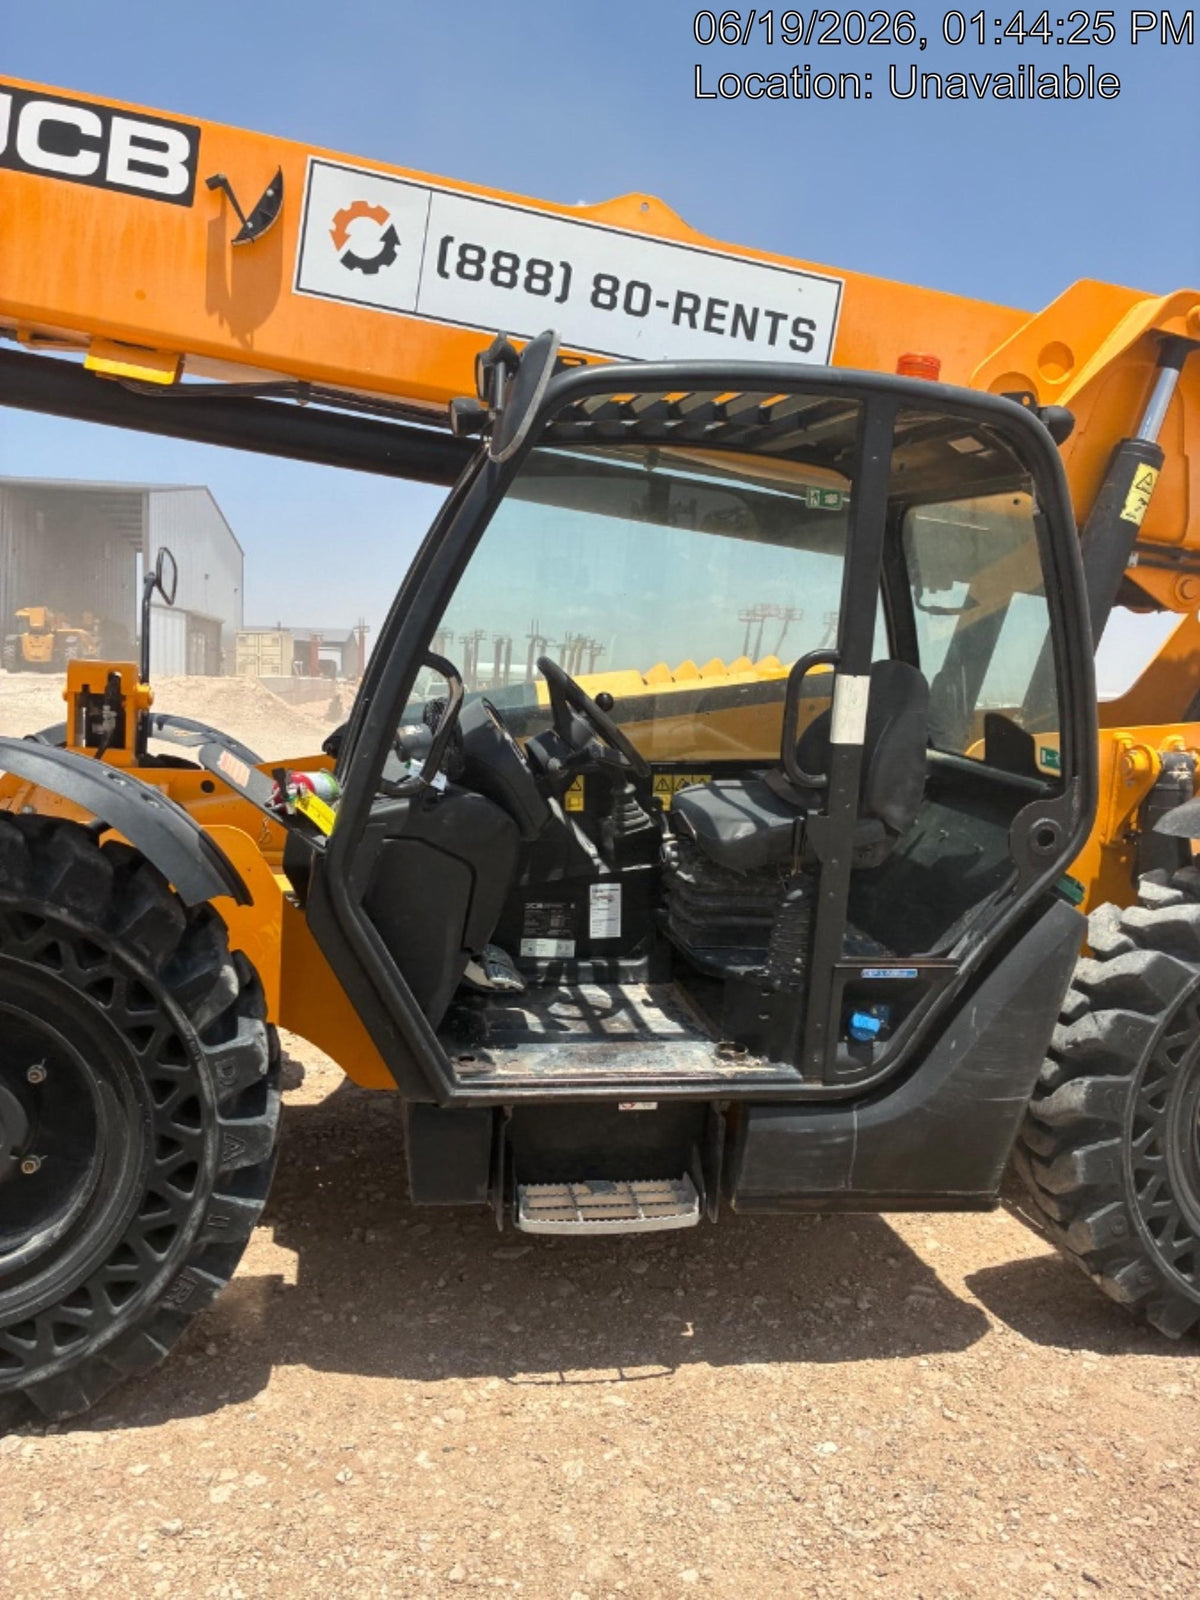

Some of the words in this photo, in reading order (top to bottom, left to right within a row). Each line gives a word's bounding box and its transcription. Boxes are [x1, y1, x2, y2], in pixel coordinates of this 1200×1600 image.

[0, 92, 191, 196] CB
[436, 234, 573, 304] (888)
[590, 272, 818, 354] 80-RENTS
